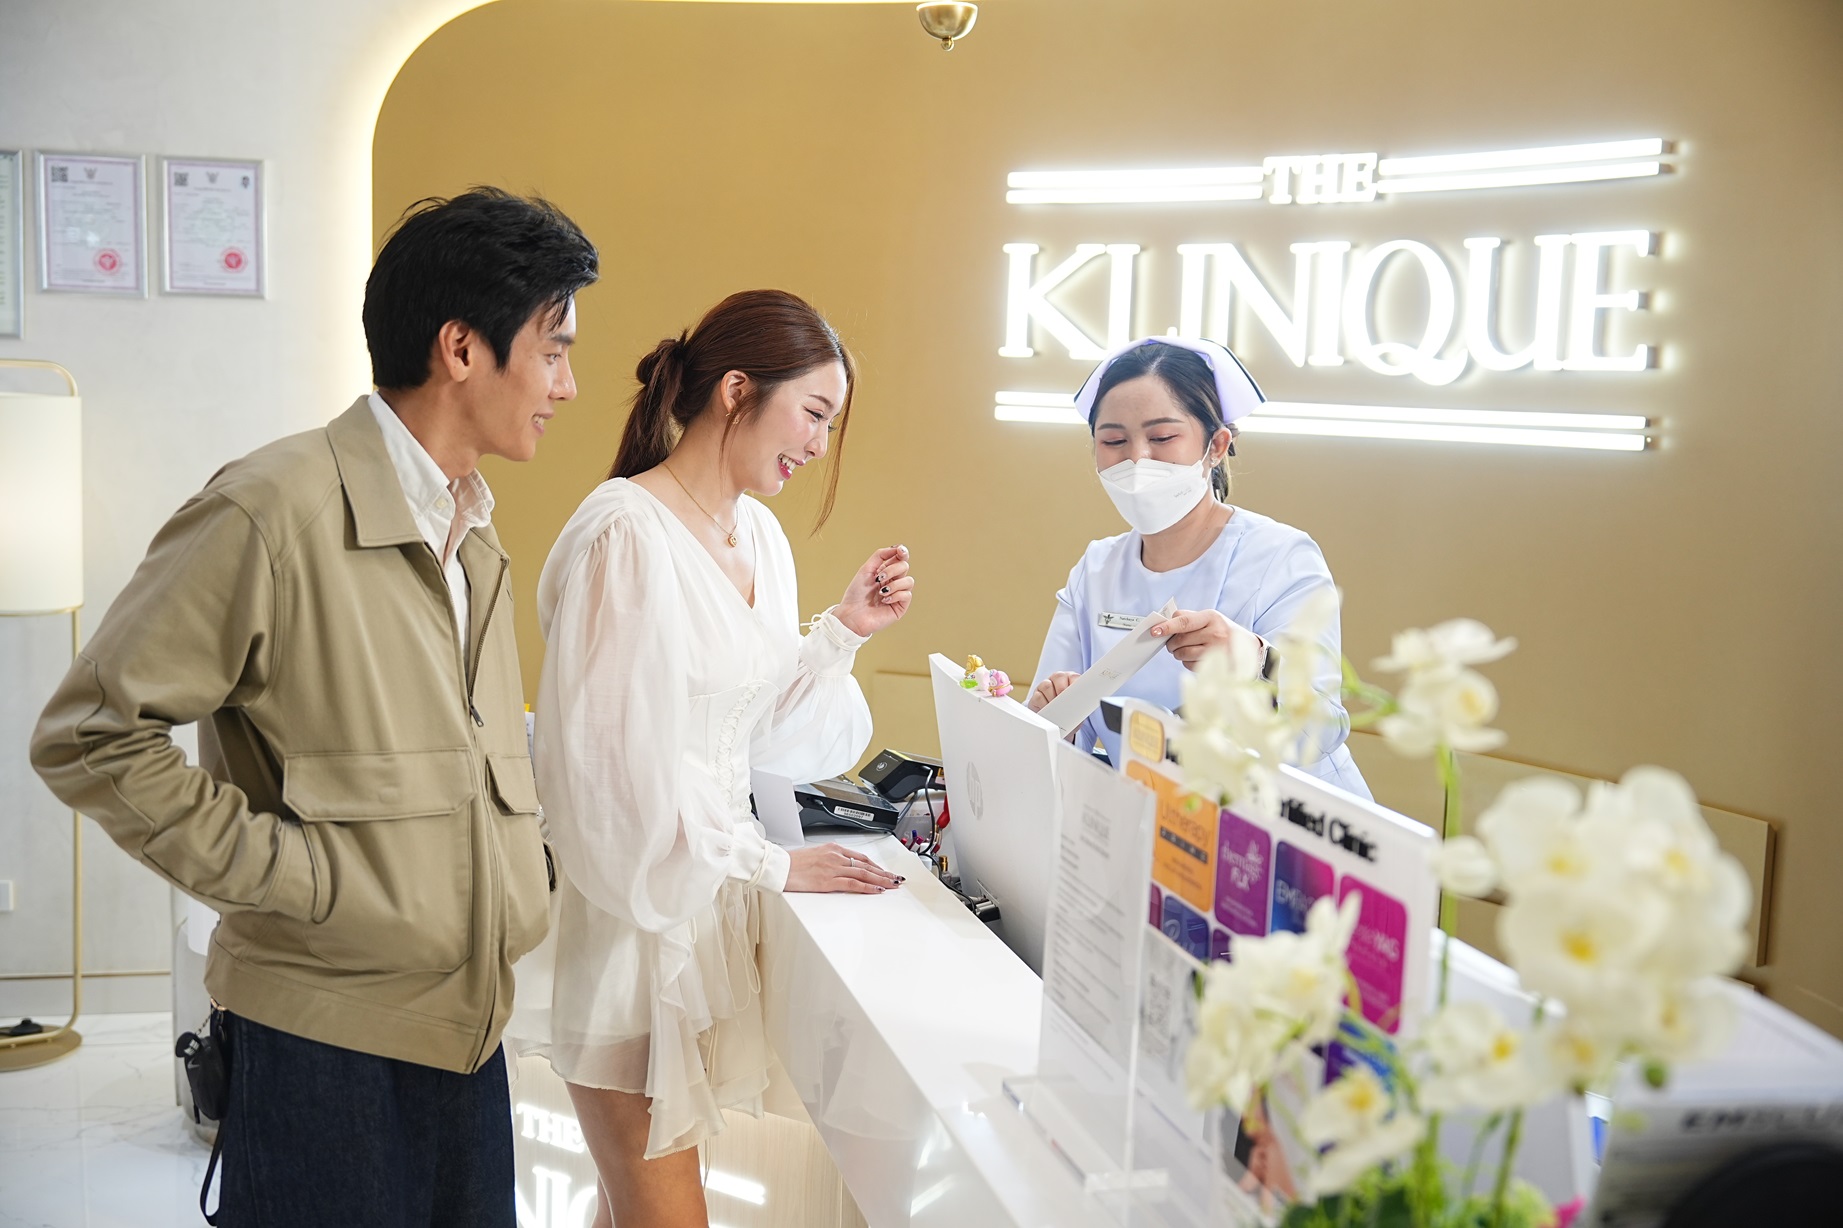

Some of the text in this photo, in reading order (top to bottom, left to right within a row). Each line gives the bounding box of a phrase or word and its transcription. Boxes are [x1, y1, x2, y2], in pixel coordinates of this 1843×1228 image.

[1262, 151, 1378, 205] THE
[997, 229, 1651, 386] KLINIQUE
[1328, 817, 1378, 862] Clinic
[515, 1102, 586, 1154] THE
